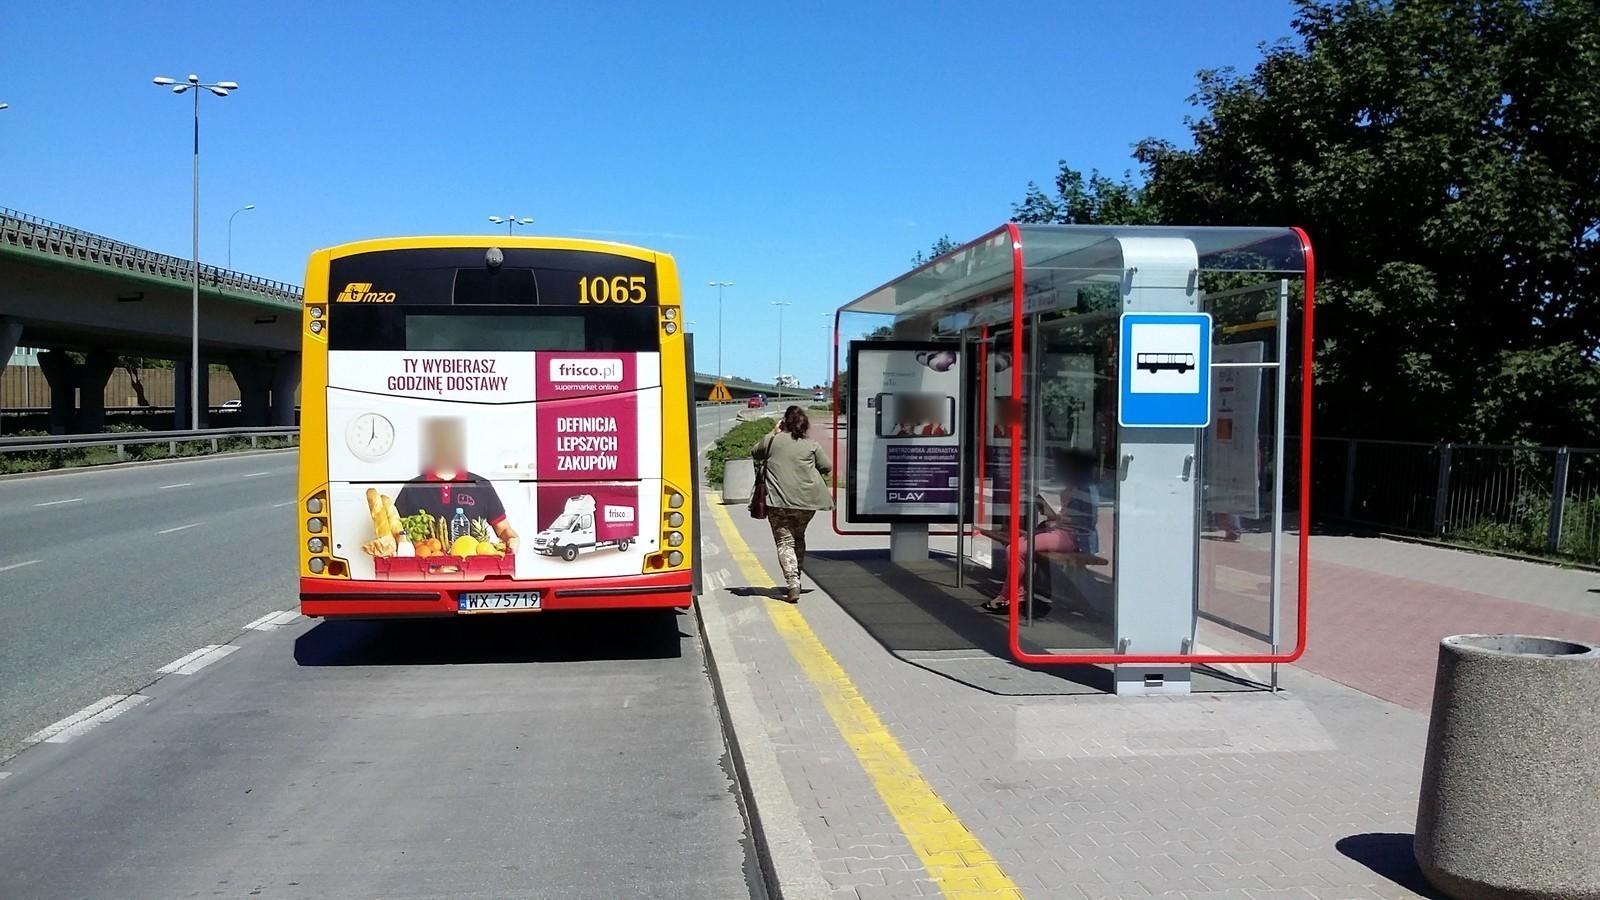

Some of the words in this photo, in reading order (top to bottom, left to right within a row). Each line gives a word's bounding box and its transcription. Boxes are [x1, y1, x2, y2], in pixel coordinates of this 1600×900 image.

[362, 291, 397, 303] mza
[578, 276, 647, 304] 1065
[403, 358, 418, 374] TY
[422, 358, 496, 374] WYBIERASZ
[559, 363, 615, 380] frisco.pl
[387, 376, 443, 395] GODZINĘ
[446, 376, 508, 391] DOSTAWY
[554, 384, 598, 392] supermarket
[557, 417, 618, 433] DEFINICJA
[557, 436, 618, 452] LEPSZYCH
[557, 452, 618, 471] ZAKUPÓW
[888, 492, 925, 501] PLAY
[468, 594, 489, 609] WX
[494, 593, 538, 608] 75719
